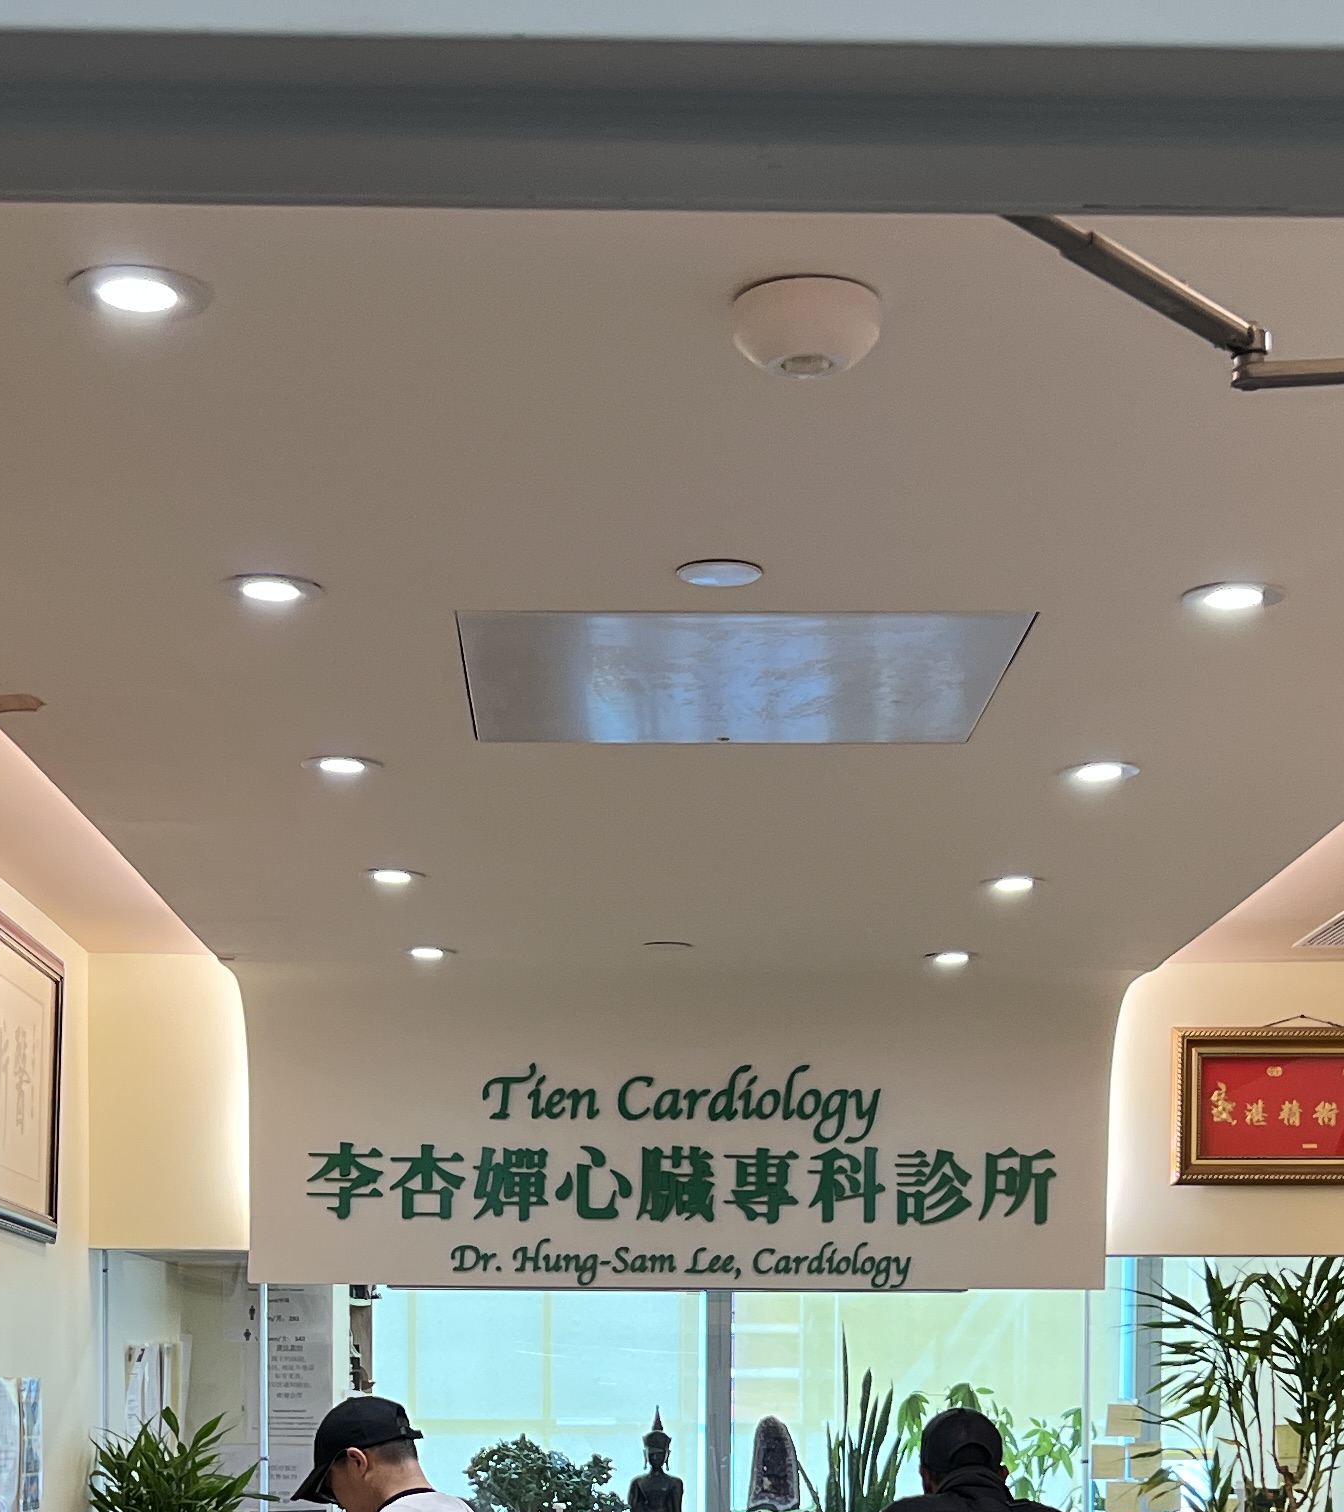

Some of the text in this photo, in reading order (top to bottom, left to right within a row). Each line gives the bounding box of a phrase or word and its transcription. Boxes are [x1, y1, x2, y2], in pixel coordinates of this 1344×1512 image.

[481, 1062, 882, 1145] Tien Cardiology
[306, 1141, 1057, 1226] 李杏嬋心臟專科診所
[450, 1237, 913, 1289] Dr. Hung-Sam Lee, Cardiology
